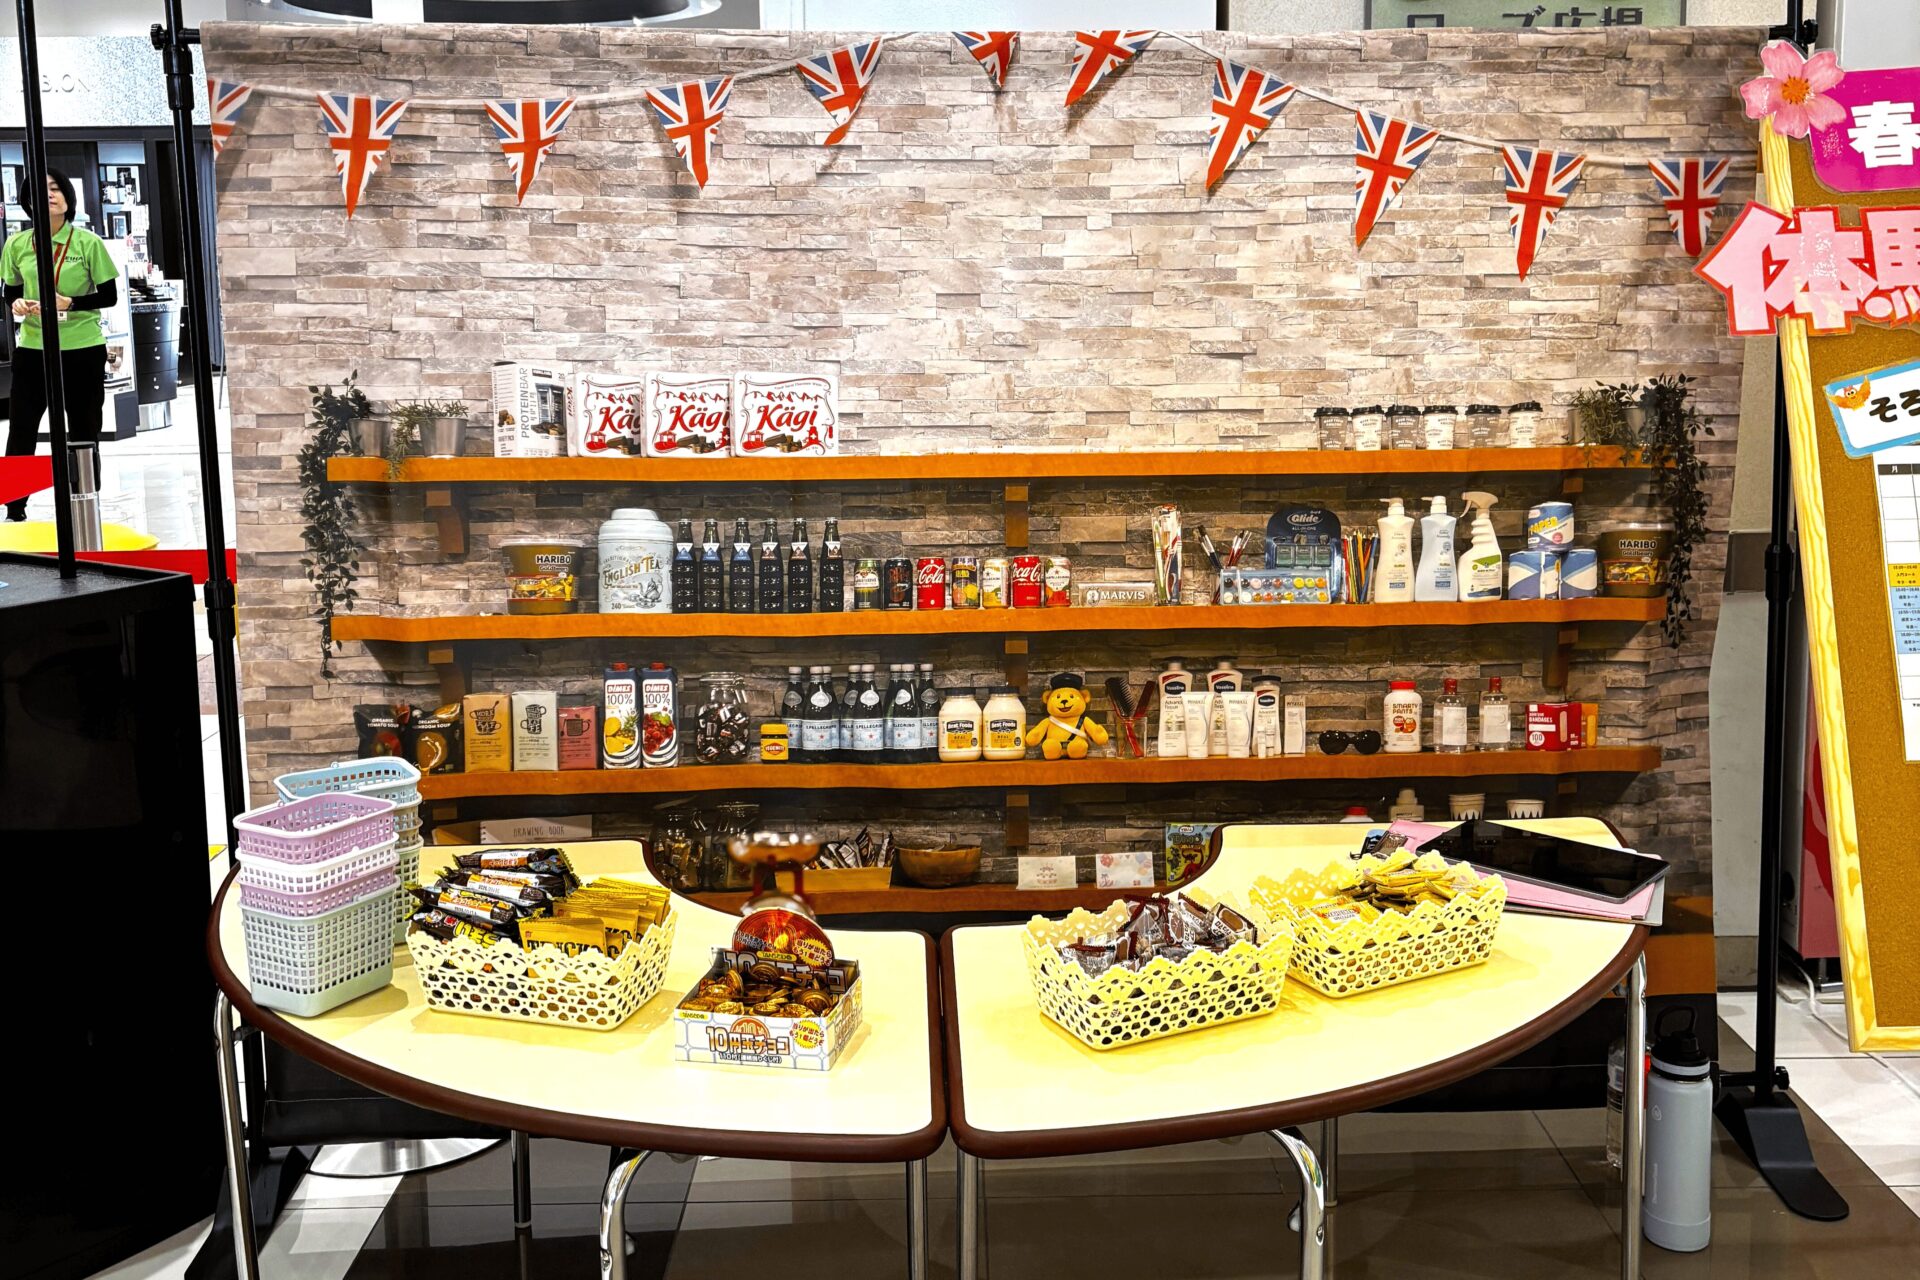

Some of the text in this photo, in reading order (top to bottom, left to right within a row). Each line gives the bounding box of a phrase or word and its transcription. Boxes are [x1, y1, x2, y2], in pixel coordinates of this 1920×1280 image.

[1847, 100, 1920, 169] 春
[757, 404, 819, 433] Kägi
[1291, 514, 1319, 522] Glide
[1619, 540, 1657, 549] HARIBO
[536, 554, 571, 564] HARIBO
[640, 554, 663, 573] TEA
[1101, 591, 1145, 600] MARVIS
[607, 694, 633, 705] 100%
[645, 693, 671, 704] 100%
[513, 826, 565, 838] DRAWING BOOK
[706, 1026, 791, 1056] 10円玉チョコ
